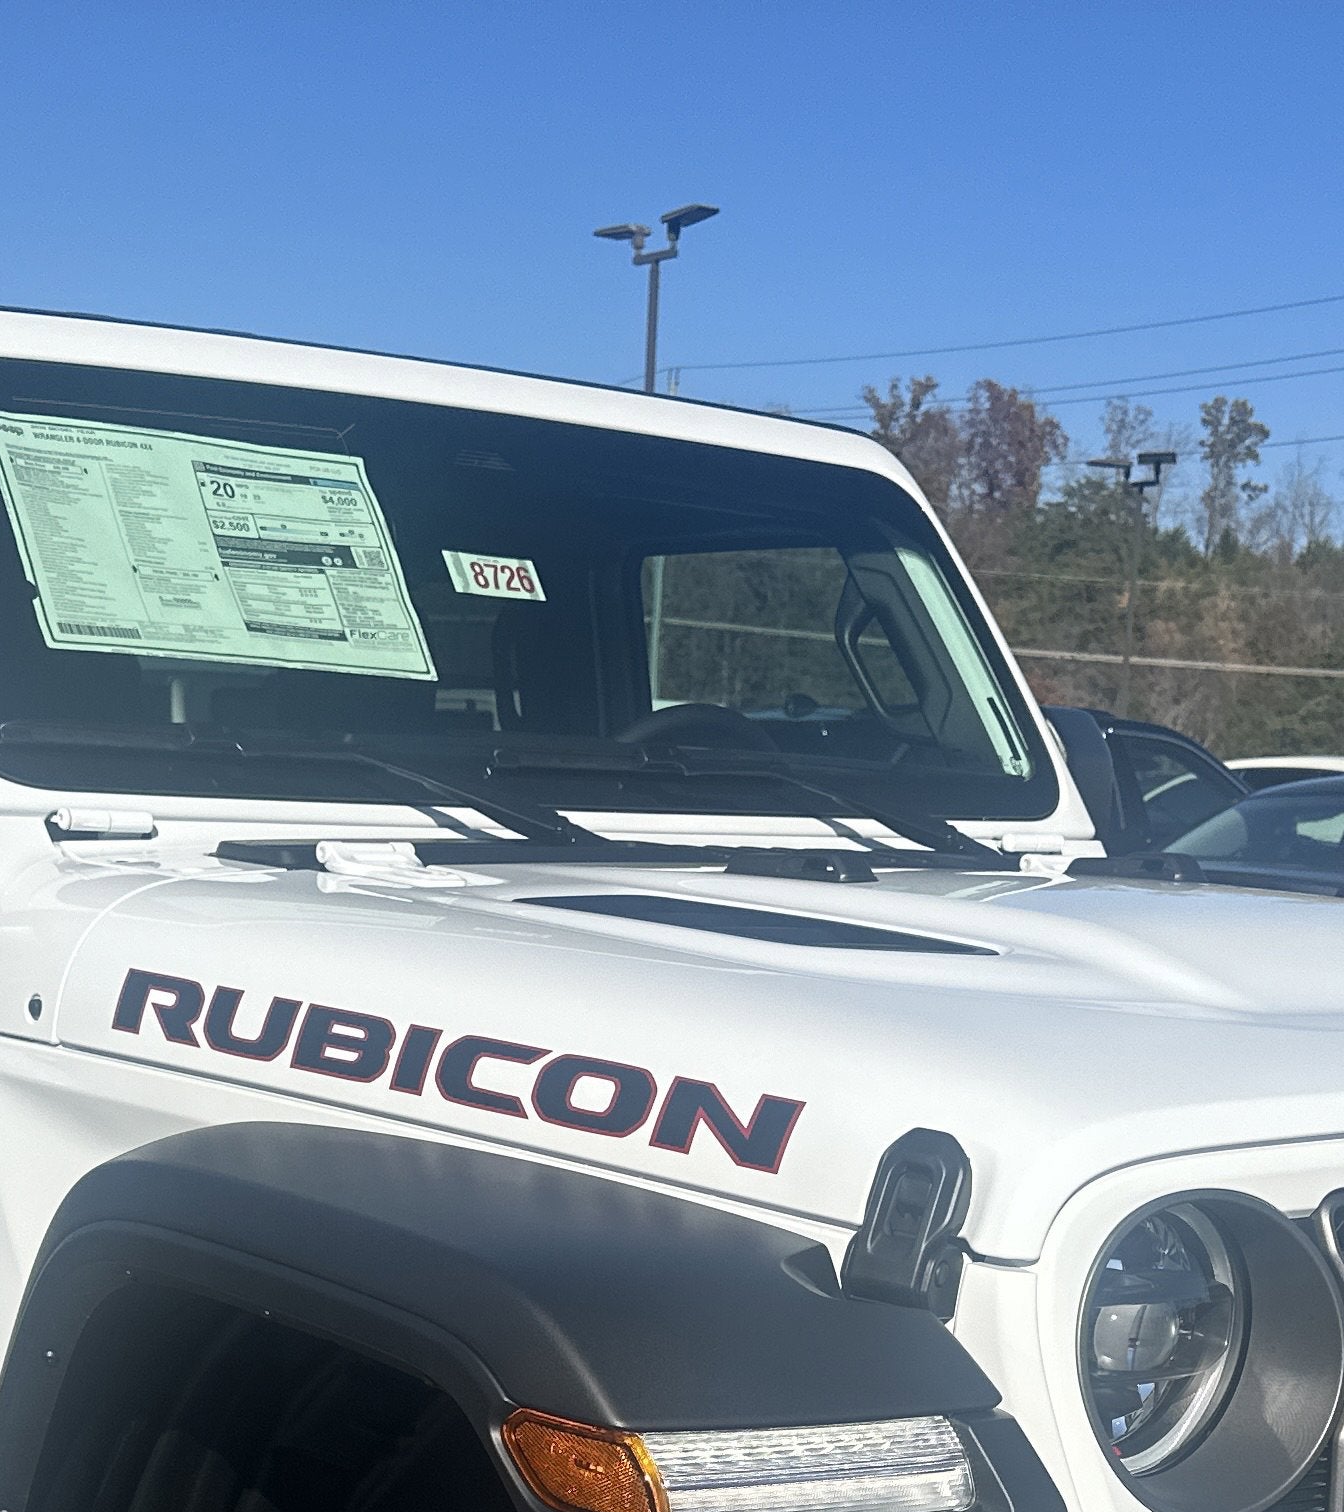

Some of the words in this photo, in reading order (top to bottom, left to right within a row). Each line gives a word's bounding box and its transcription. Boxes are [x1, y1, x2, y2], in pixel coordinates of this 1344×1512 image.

[210, 480, 235, 499] 20
[321, 495, 358, 507] $4,000
[212, 519, 250, 532] $2,500
[470, 561, 535, 593] 8726
[350, 629, 410, 641] FlexCare
[112, 967, 807, 1175] RUBICON
